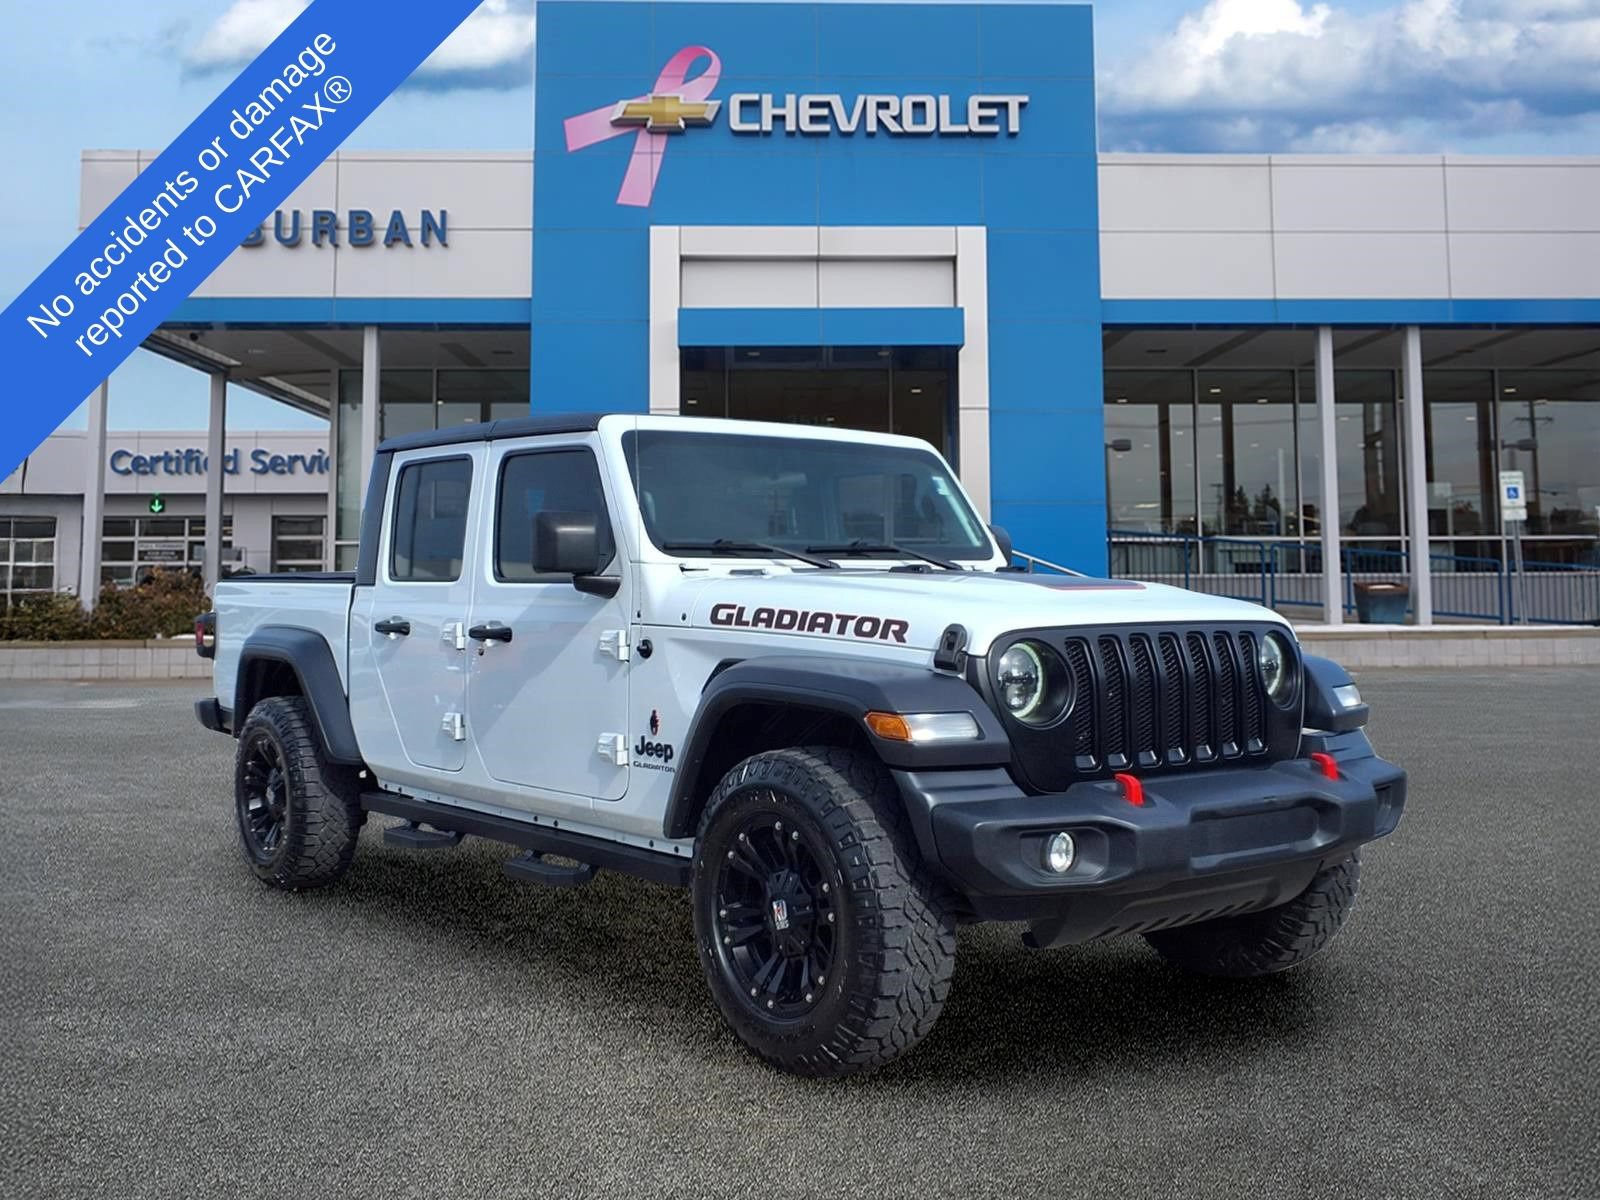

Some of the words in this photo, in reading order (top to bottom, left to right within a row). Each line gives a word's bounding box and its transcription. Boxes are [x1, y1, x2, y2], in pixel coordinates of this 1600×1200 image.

[729, 93, 1029, 134] CHEVROLET
[709, 603, 910, 644] GLADIATOR
[634, 735, 674, 763] Jeep
[633, 760, 675, 773] GLADIATOR
